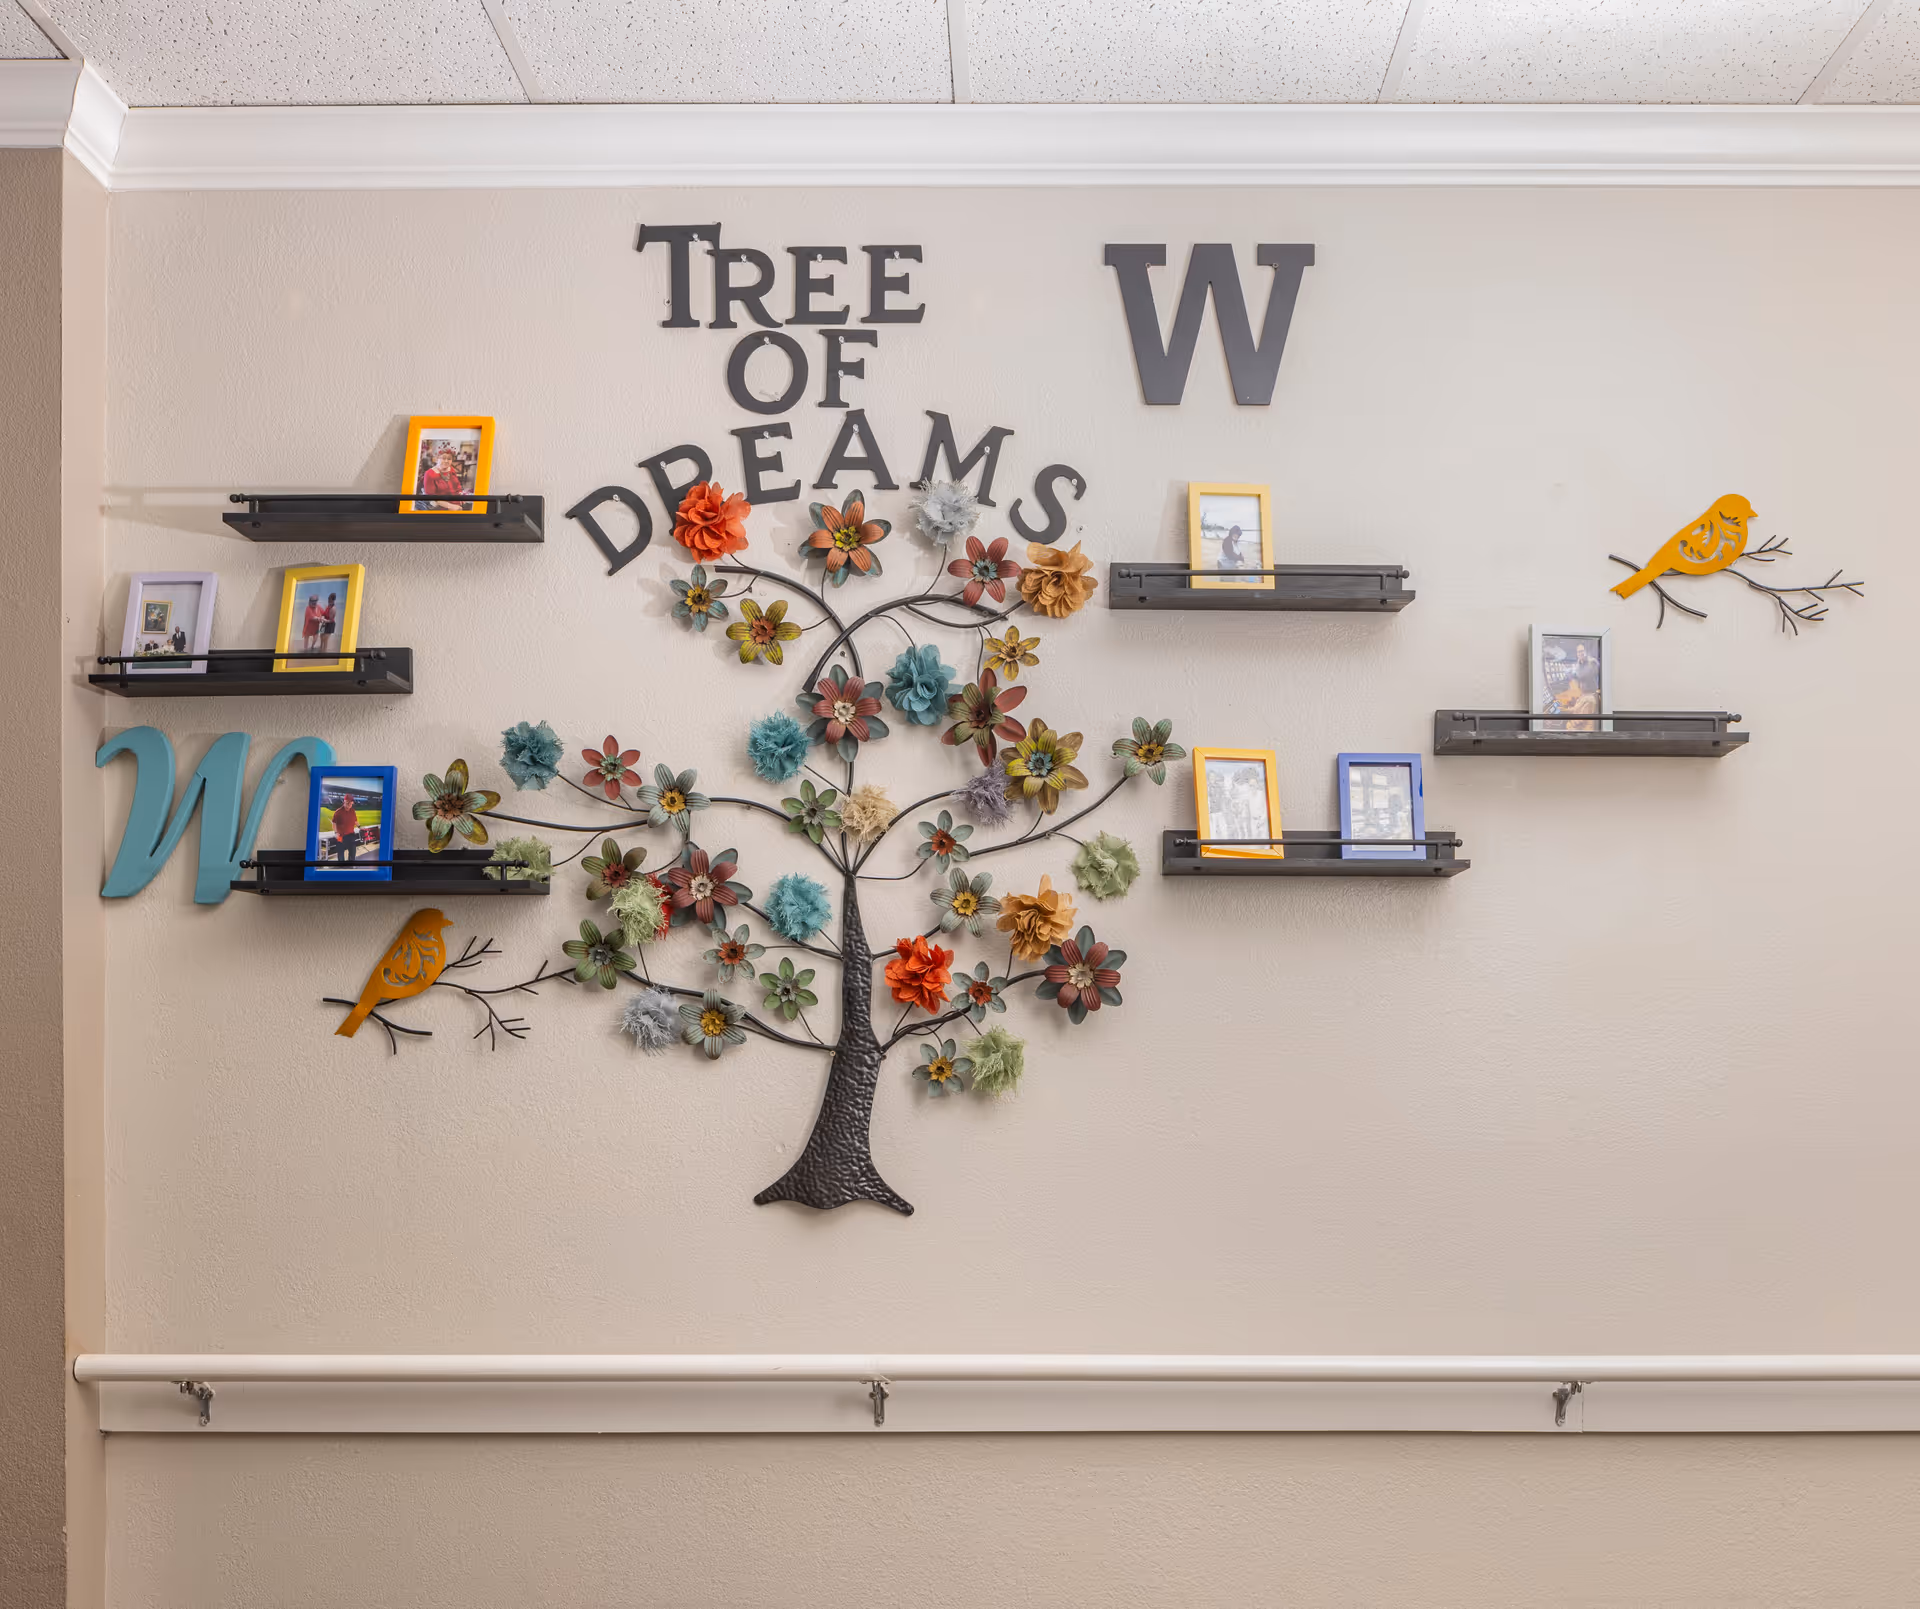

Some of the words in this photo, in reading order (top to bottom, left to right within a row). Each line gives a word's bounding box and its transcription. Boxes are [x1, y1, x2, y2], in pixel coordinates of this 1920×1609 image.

[633, 221, 926, 329] TREE
[1104, 243, 1315, 405] W
[727, 329, 878, 415] OF
